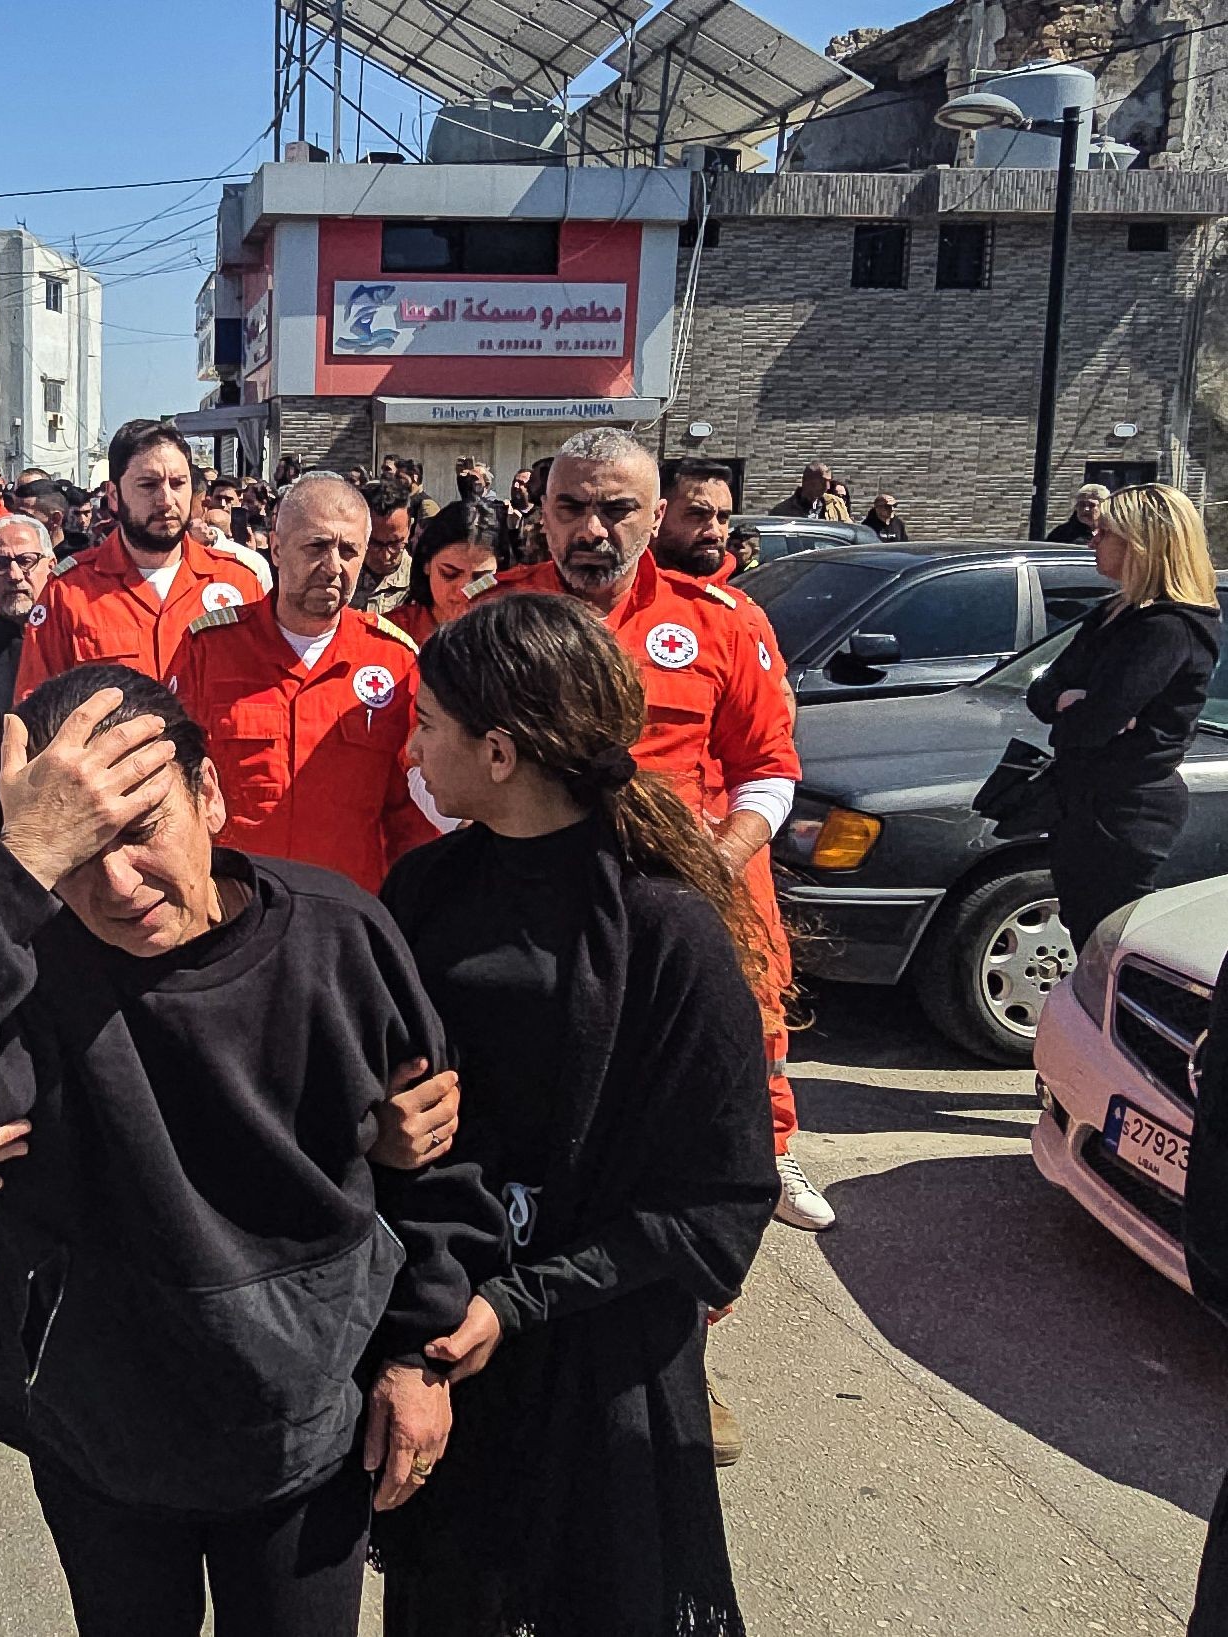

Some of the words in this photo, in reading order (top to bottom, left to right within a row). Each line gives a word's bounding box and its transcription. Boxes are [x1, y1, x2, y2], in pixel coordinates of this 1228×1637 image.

[461, 297, 537, 323] مسمكة
[540, 305, 553, 329] و
[555, 300, 622, 330] مطعم
[431, 406, 479, 421] Fishery
[483, 407, 492, 418] &
